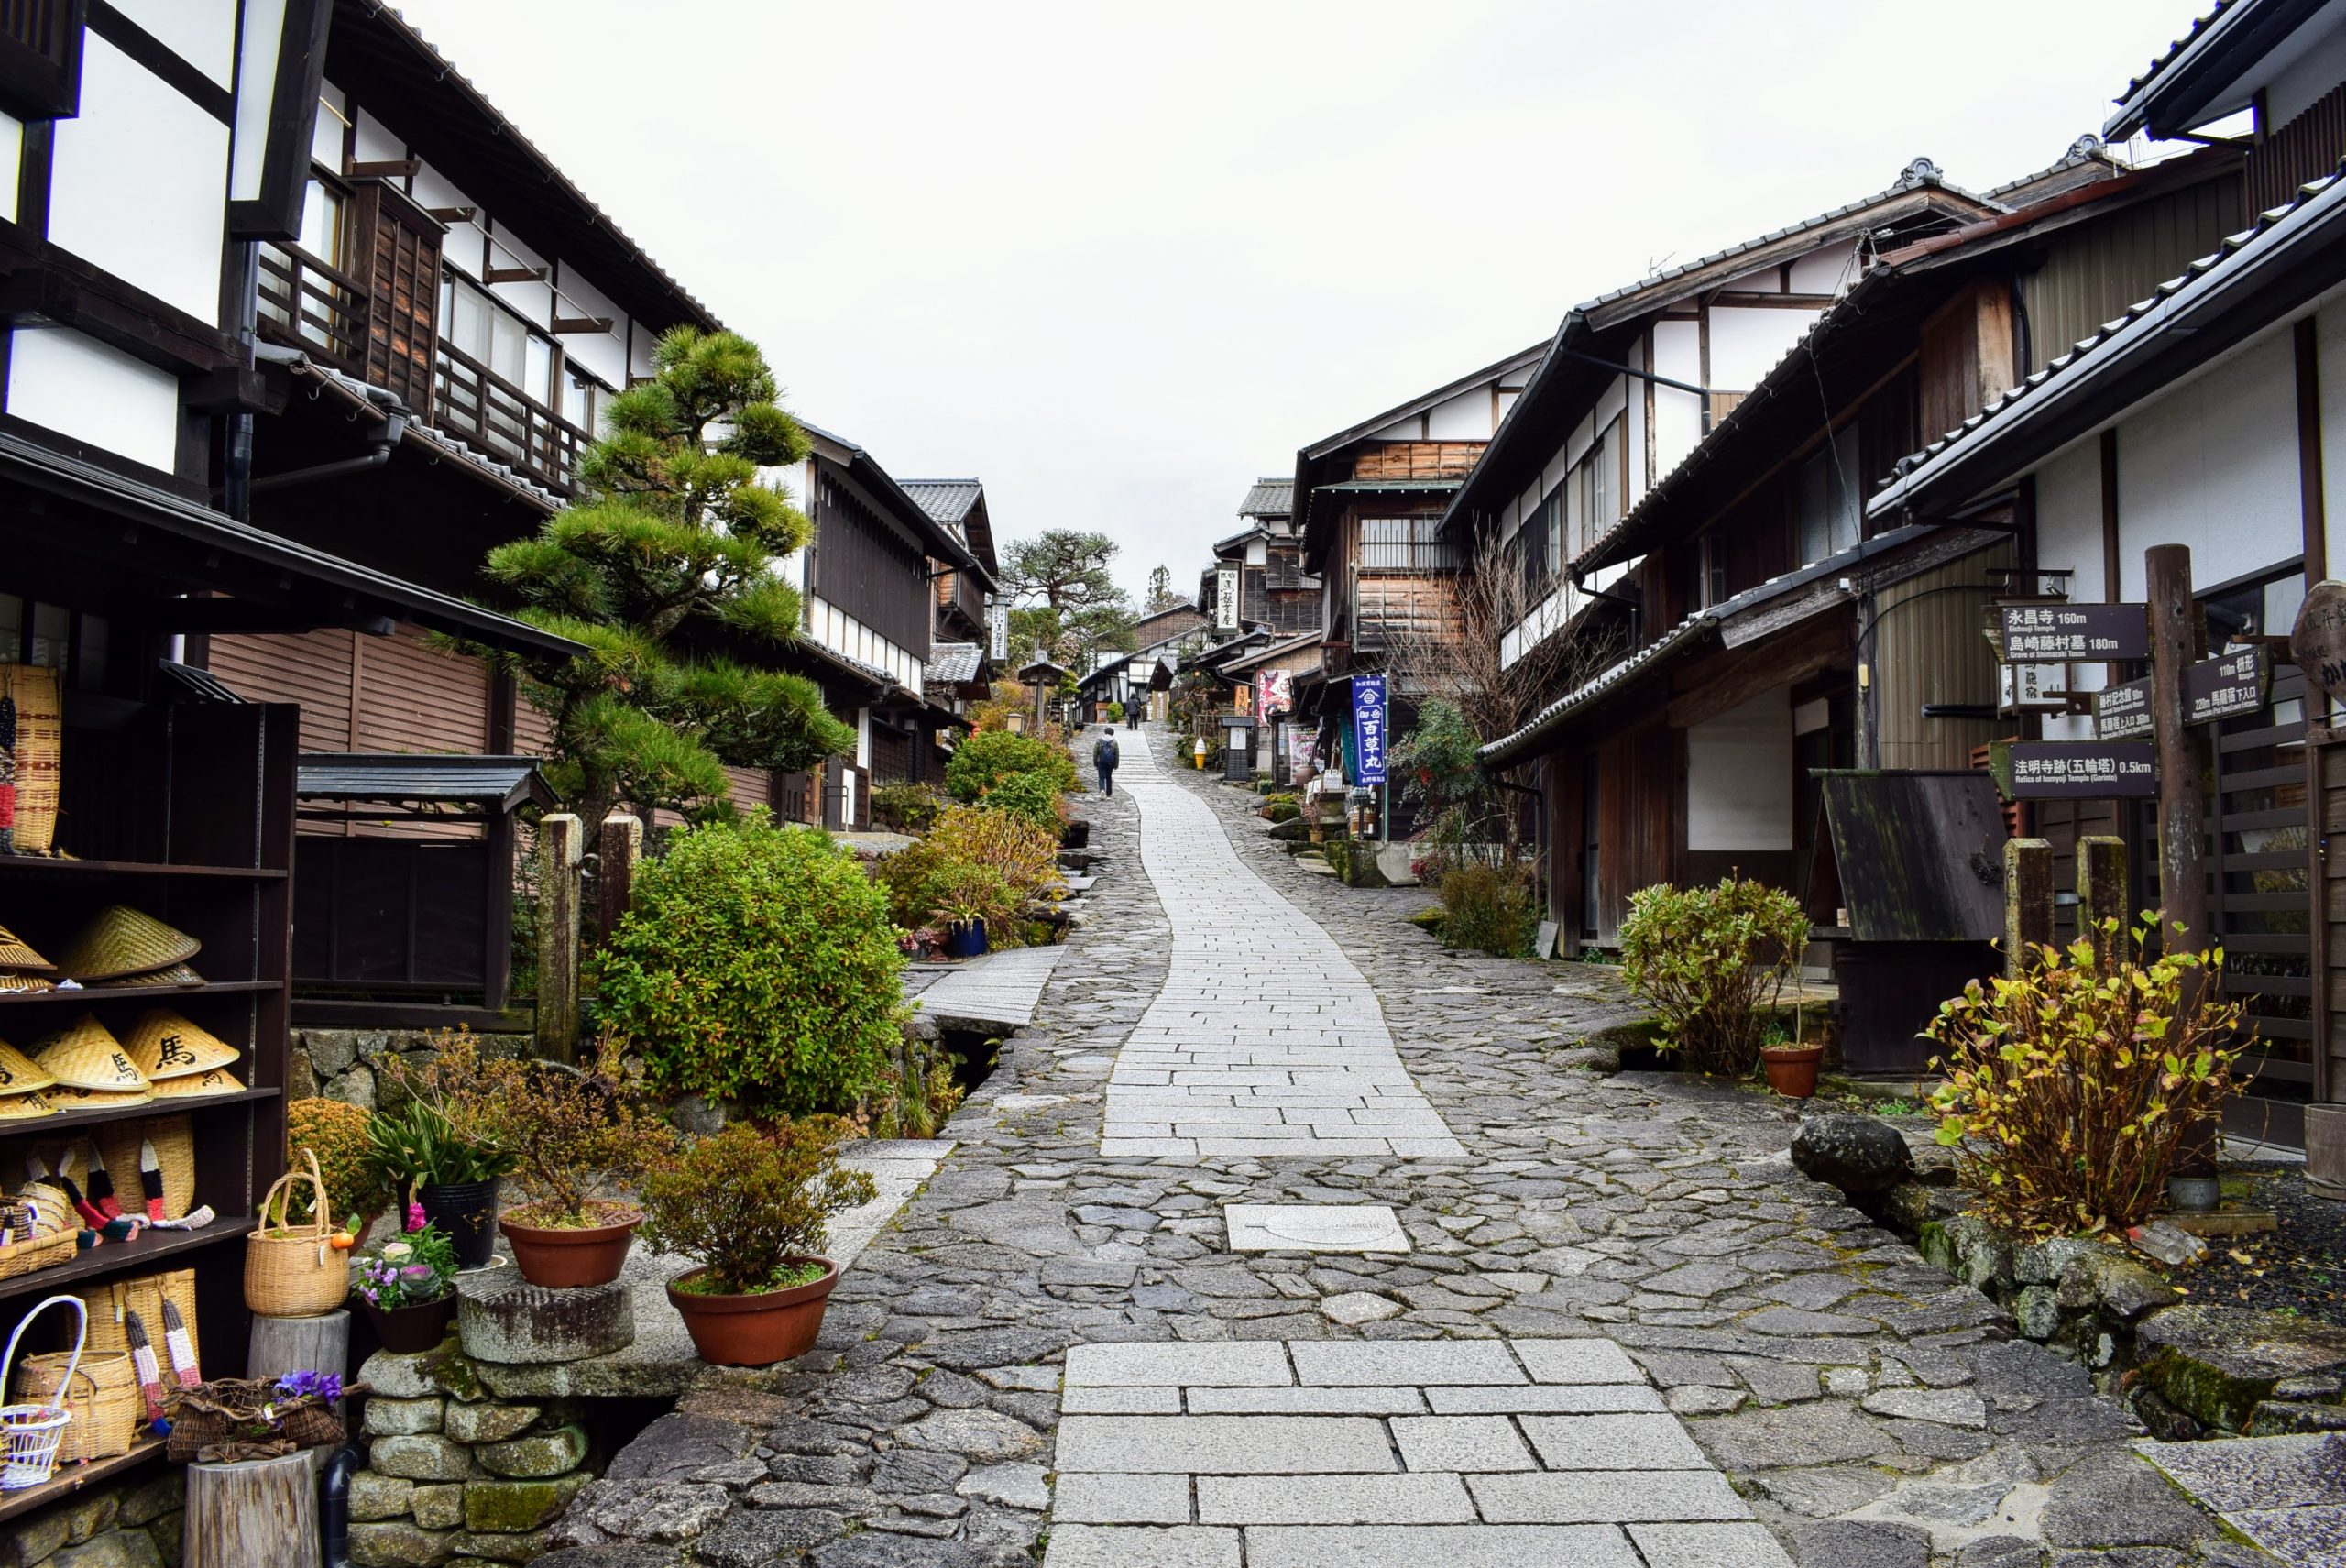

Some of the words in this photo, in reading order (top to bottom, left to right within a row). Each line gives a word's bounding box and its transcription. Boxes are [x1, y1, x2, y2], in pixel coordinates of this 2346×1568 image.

[2008, 609, 2054, 625] 永昌寺
[2057, 612, 2087, 624] 160m
[2034, 624, 2056, 632] Temple
[2009, 635, 2086, 652] 島崎藤村墓
[2089, 638, 2118, 650] 180m
[2010, 651, 2028, 659] Grave
[2036, 650, 2066, 658] Shimazaki
[2220, 664, 2236, 677] 110m
[1359, 709, 1381, 719] 御岳
[1361, 719, 1382, 769] 百草丸
[2119, 762, 2152, 773] 0.5km
[2067, 774, 2089, 783] Temple
[2090, 773, 2118, 783] (Gorinto)
[156, 1035, 196, 1069] 馬
[111, 1052, 138, 1083] 馬
